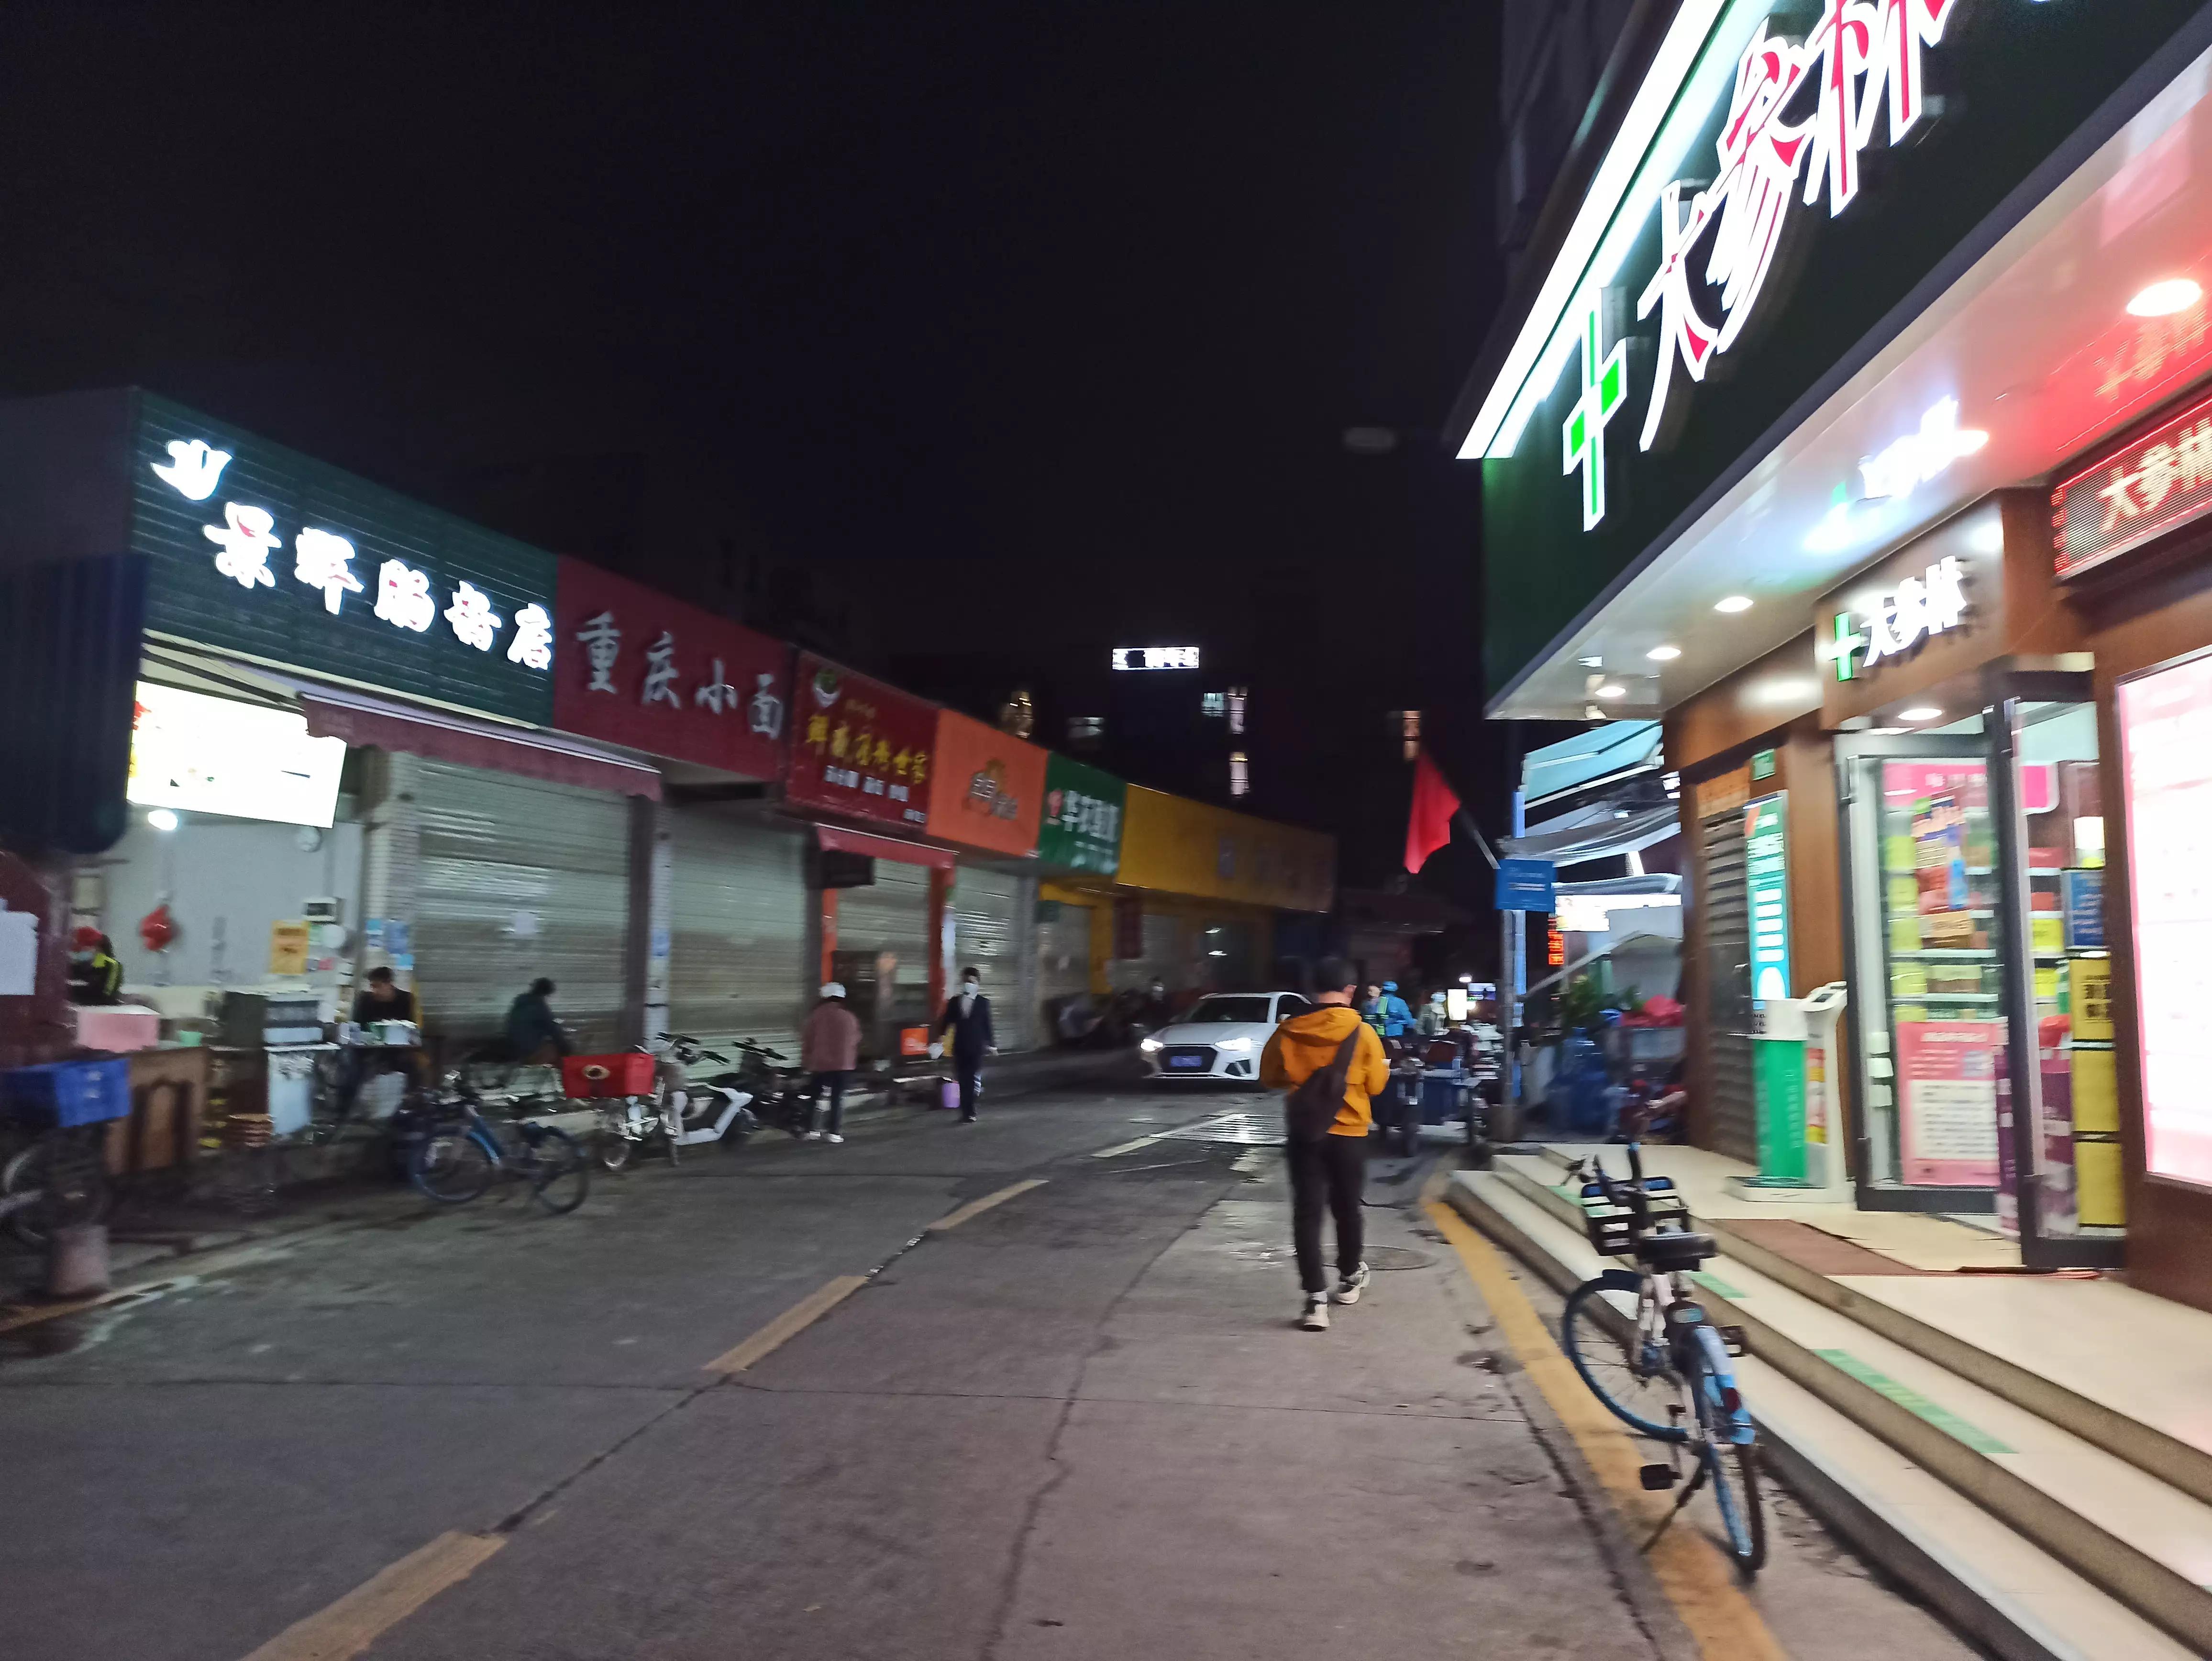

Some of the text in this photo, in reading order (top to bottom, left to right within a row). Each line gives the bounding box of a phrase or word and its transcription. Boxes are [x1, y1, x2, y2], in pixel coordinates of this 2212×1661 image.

[1637, 0, 1953, 453] 大参林
[576, 611, 784, 740] 重庆小面
